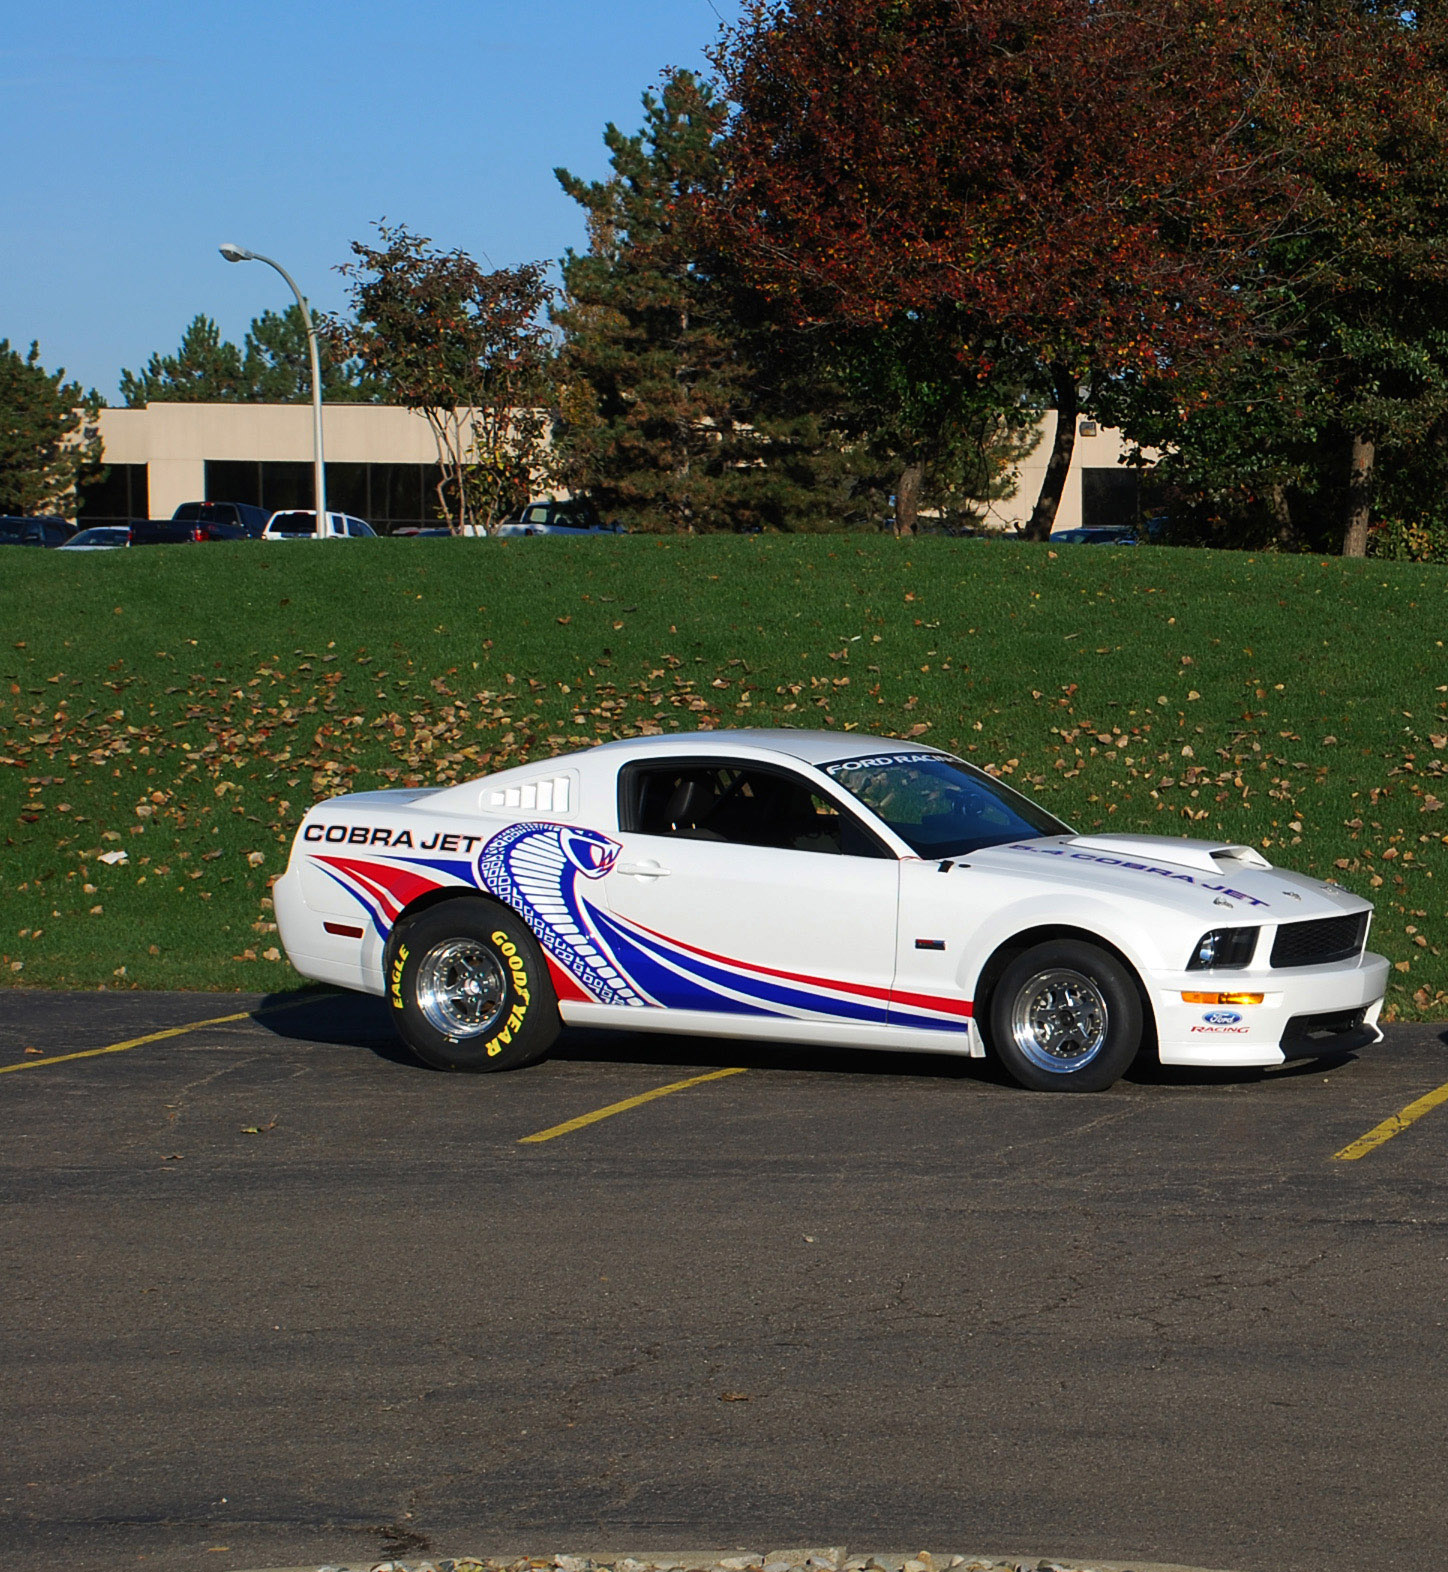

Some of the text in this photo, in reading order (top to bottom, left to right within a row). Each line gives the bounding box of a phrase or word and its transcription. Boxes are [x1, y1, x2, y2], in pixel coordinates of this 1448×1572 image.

[826, 757, 893, 775] FORD
[303, 824, 482, 853] COBRA JET
[1070, 853, 1196, 884] COBRA
[1201, 883, 1271, 907] JET
[391, 944, 409, 1009] EAGLE
[485, 930, 531, 1057] GOODYEAR
[1190, 1026, 1250, 1034] RACING
[1209, 1012, 1236, 1024] Ford
